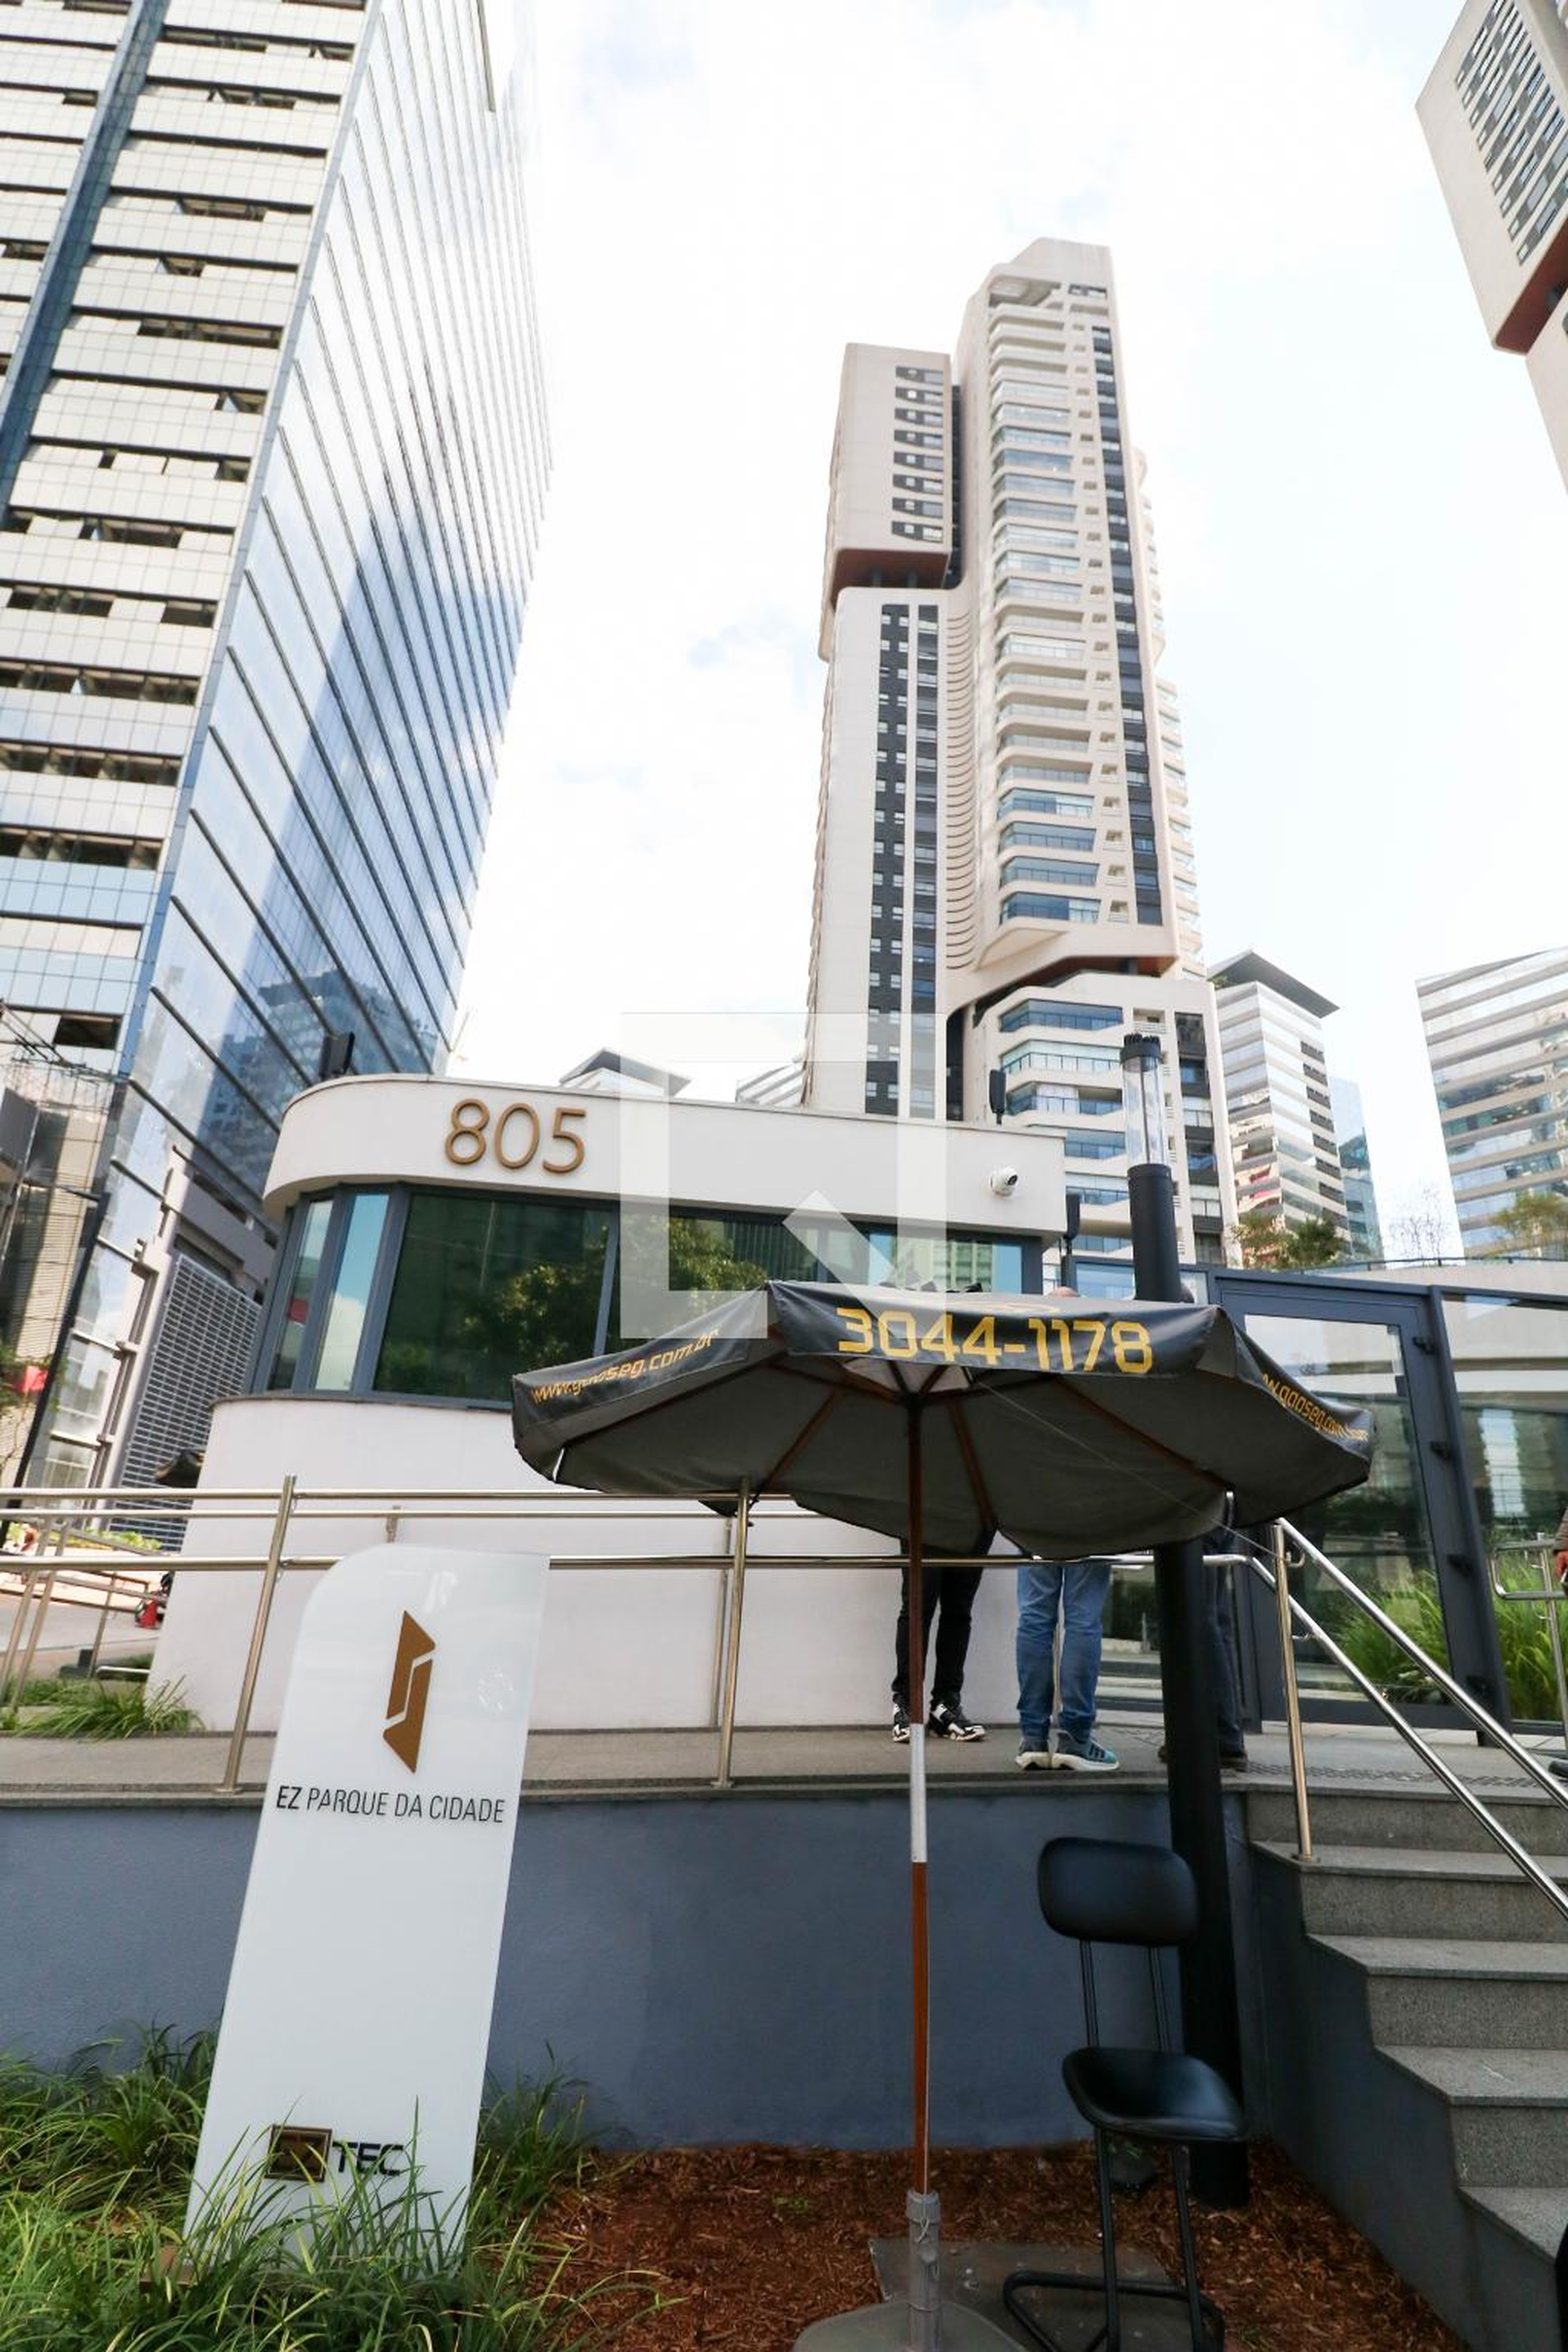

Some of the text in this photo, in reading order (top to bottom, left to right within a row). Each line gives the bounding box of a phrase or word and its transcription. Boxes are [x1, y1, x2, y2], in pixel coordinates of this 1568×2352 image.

[445, 1098, 587, 1174] 805
[836, 1306, 1152, 1374] 3044-1178
[276, 1785, 506, 1823] EZ PARQUE DA CIDADE
